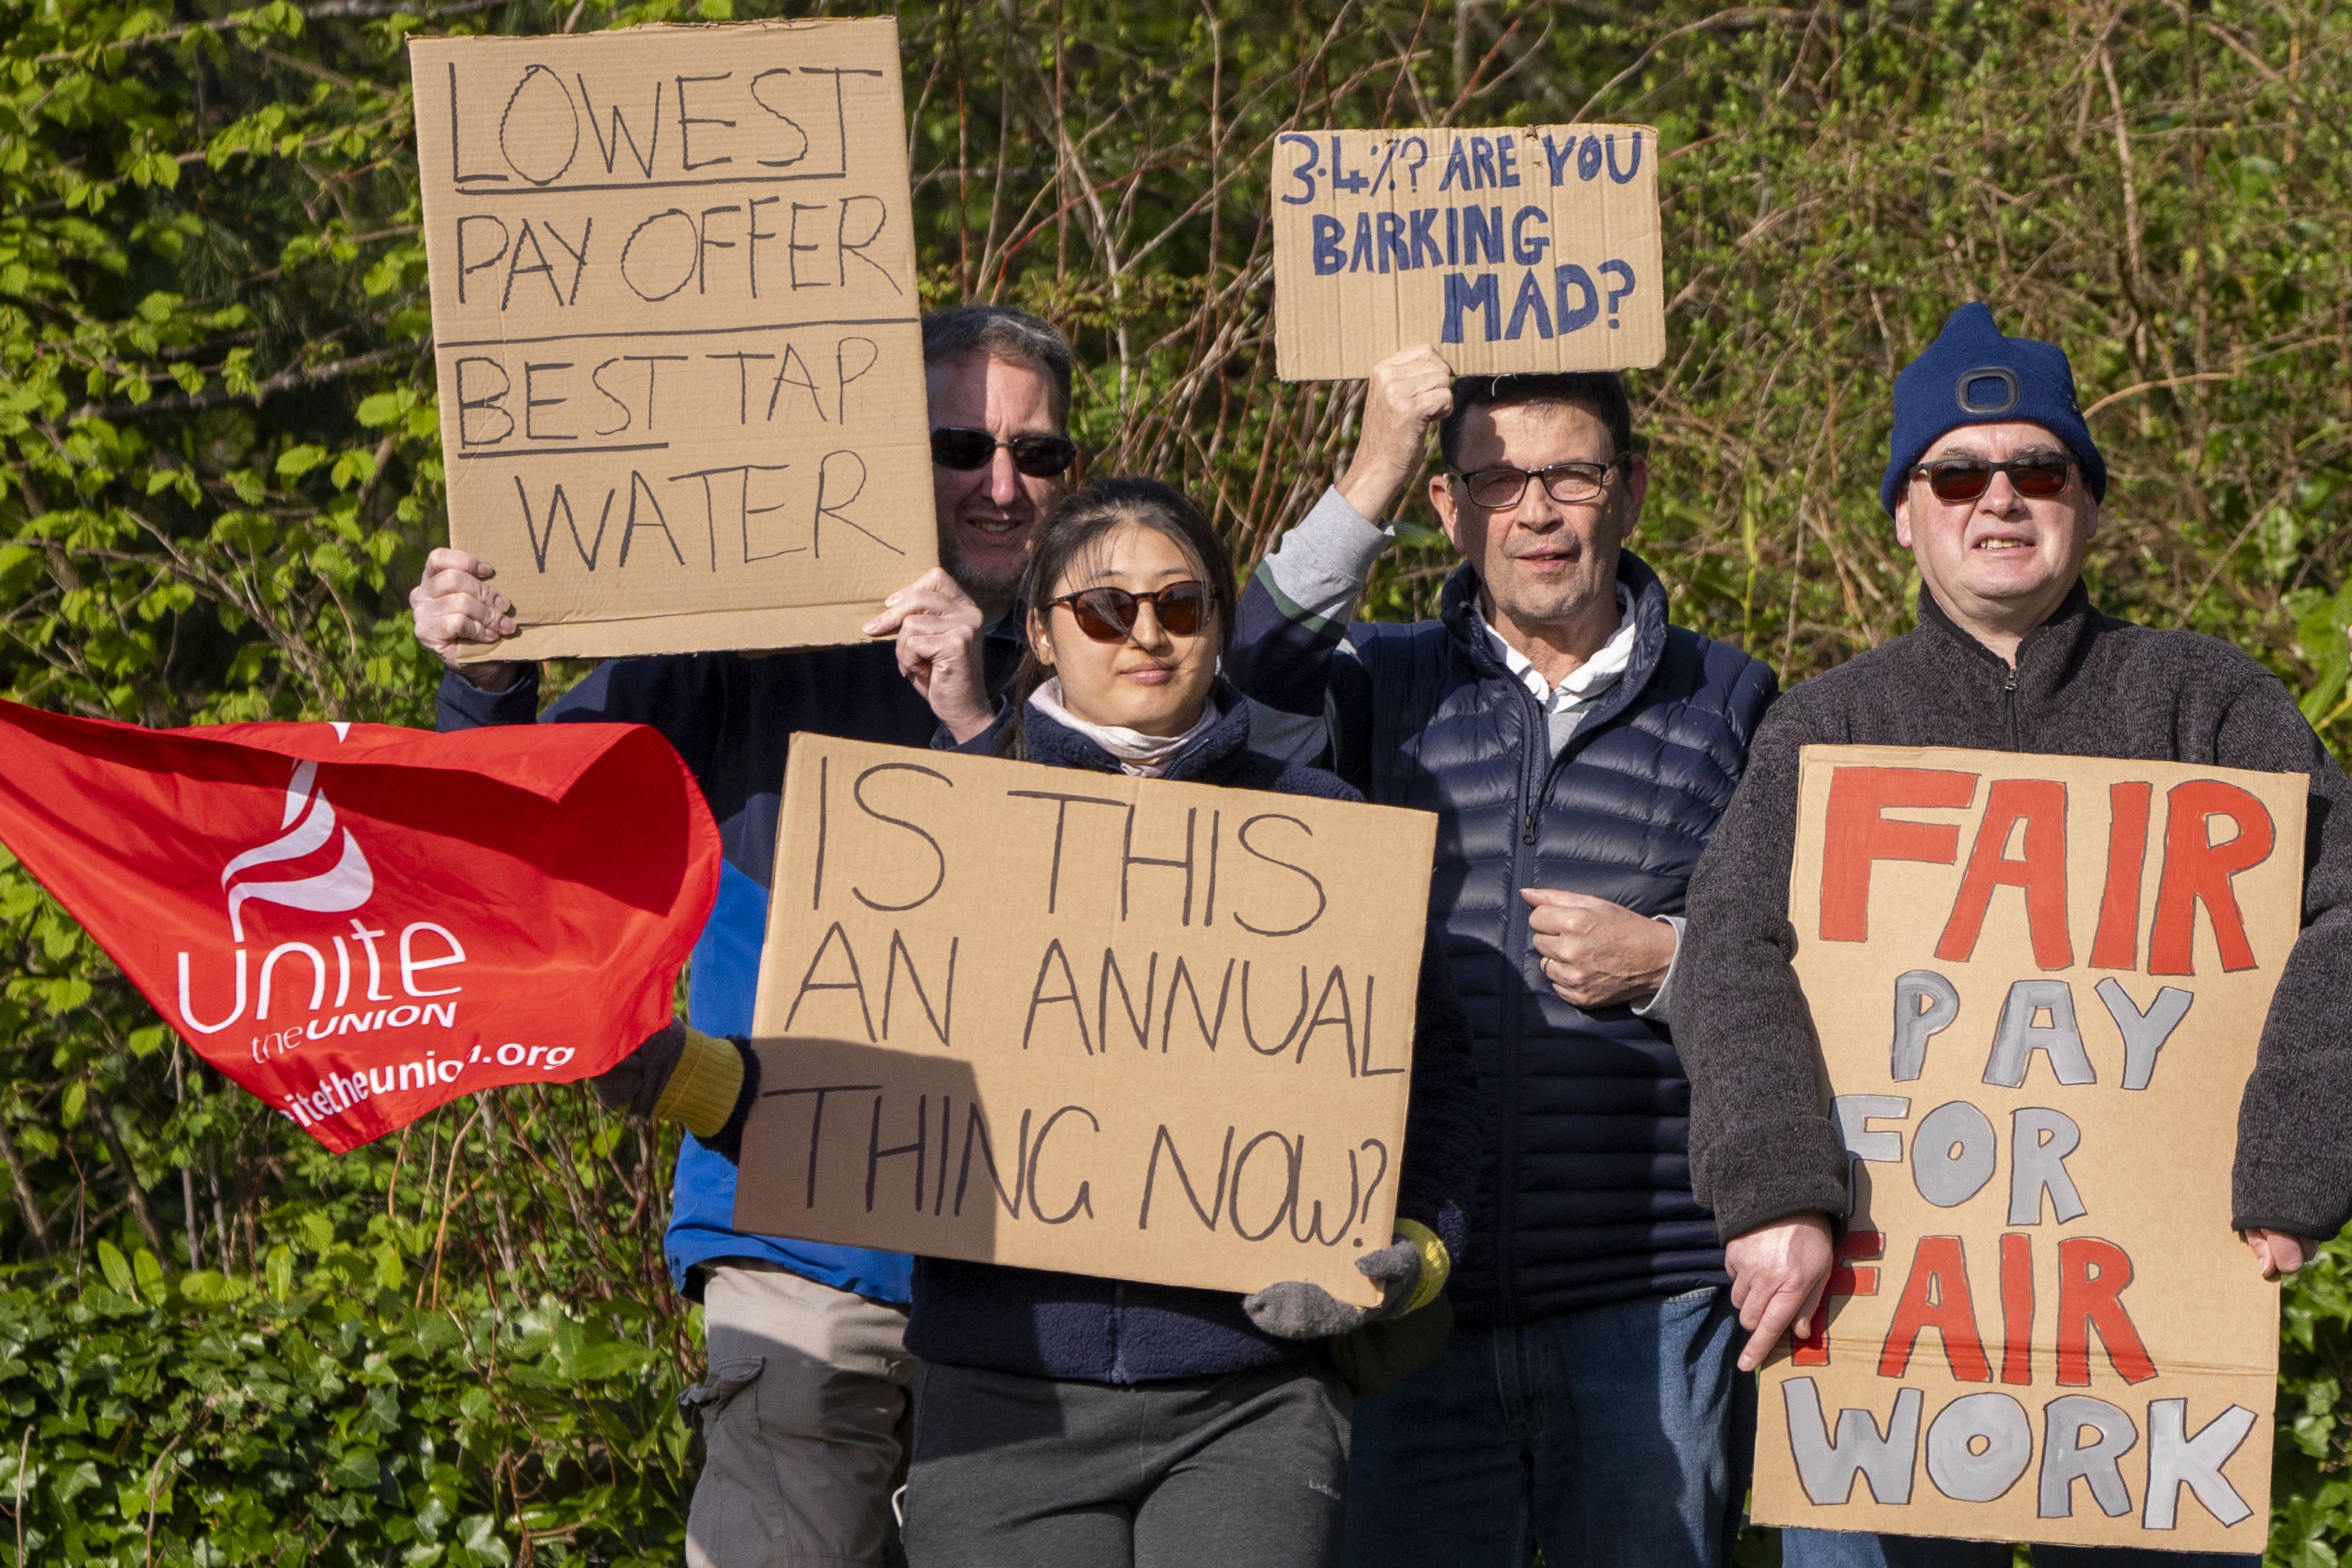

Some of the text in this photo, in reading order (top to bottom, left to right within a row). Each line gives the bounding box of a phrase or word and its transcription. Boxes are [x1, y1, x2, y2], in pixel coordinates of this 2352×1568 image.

[448, 62, 883, 185] LOWEST
[1439, 134, 1521, 192] ARE
[1541, 131, 1641, 186] YOU
[457, 195, 903, 312] PAY OFFER
[1312, 204, 1550, 276] BARKING
[1440, 259, 1636, 345] MAD?
[456, 336, 878, 450] BEST TAP
[514, 449, 905, 574] WATER
[813, 756, 1327, 938] IS THIS
[1818, 765, 2276, 977] FAIR
[783, 921, 1406, 1079] AN ANNUAL
[1891, 969, 2195, 1091] PAY
[760, 1084, 1389, 1249] THING NOW?
[1829, 1093, 2088, 1226] FOR
[1791, 1231, 2159, 1387] FAIR
[1780, 1375, 2259, 1531] WORK
